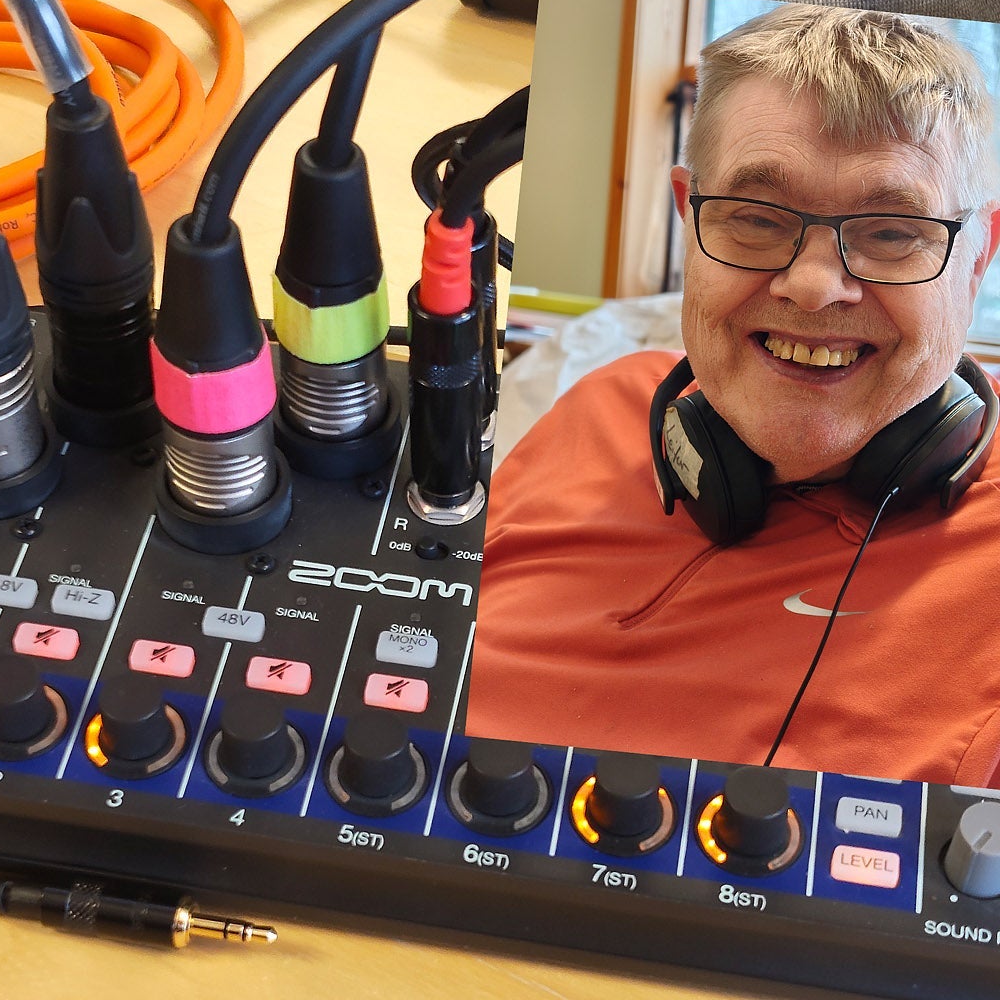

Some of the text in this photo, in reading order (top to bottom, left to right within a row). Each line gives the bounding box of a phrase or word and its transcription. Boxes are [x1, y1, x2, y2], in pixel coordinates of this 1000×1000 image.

[393, 517, 408, 531] R
[389, 541, 412, 551] 0dB
[48, 573, 93, 588] SIGNAL
[288, 559, 473, 606] ZOOM
[65, 588, 102, 605] Hi-Z
[161, 590, 206, 605] SIGNAL
[217, 612, 251, 626] 48V
[275, 607, 320, 622] SIGNAL
[389, 623, 434, 637] SIGNAL
[389, 633, 428, 647] MONO
[106, 790, 124, 808] 3
[229, 808, 246, 827] 4
[854, 805, 888, 821] PAN
[337, 824, 385, 850] 5(ST)
[463, 844, 510, 870] 6(ST)
[840, 853, 894, 872] LEVEL
[592, 863, 637, 891] 7(ST)
[718, 884, 767, 911] 8(ST)
[924, 920, 992, 943] SOUND
